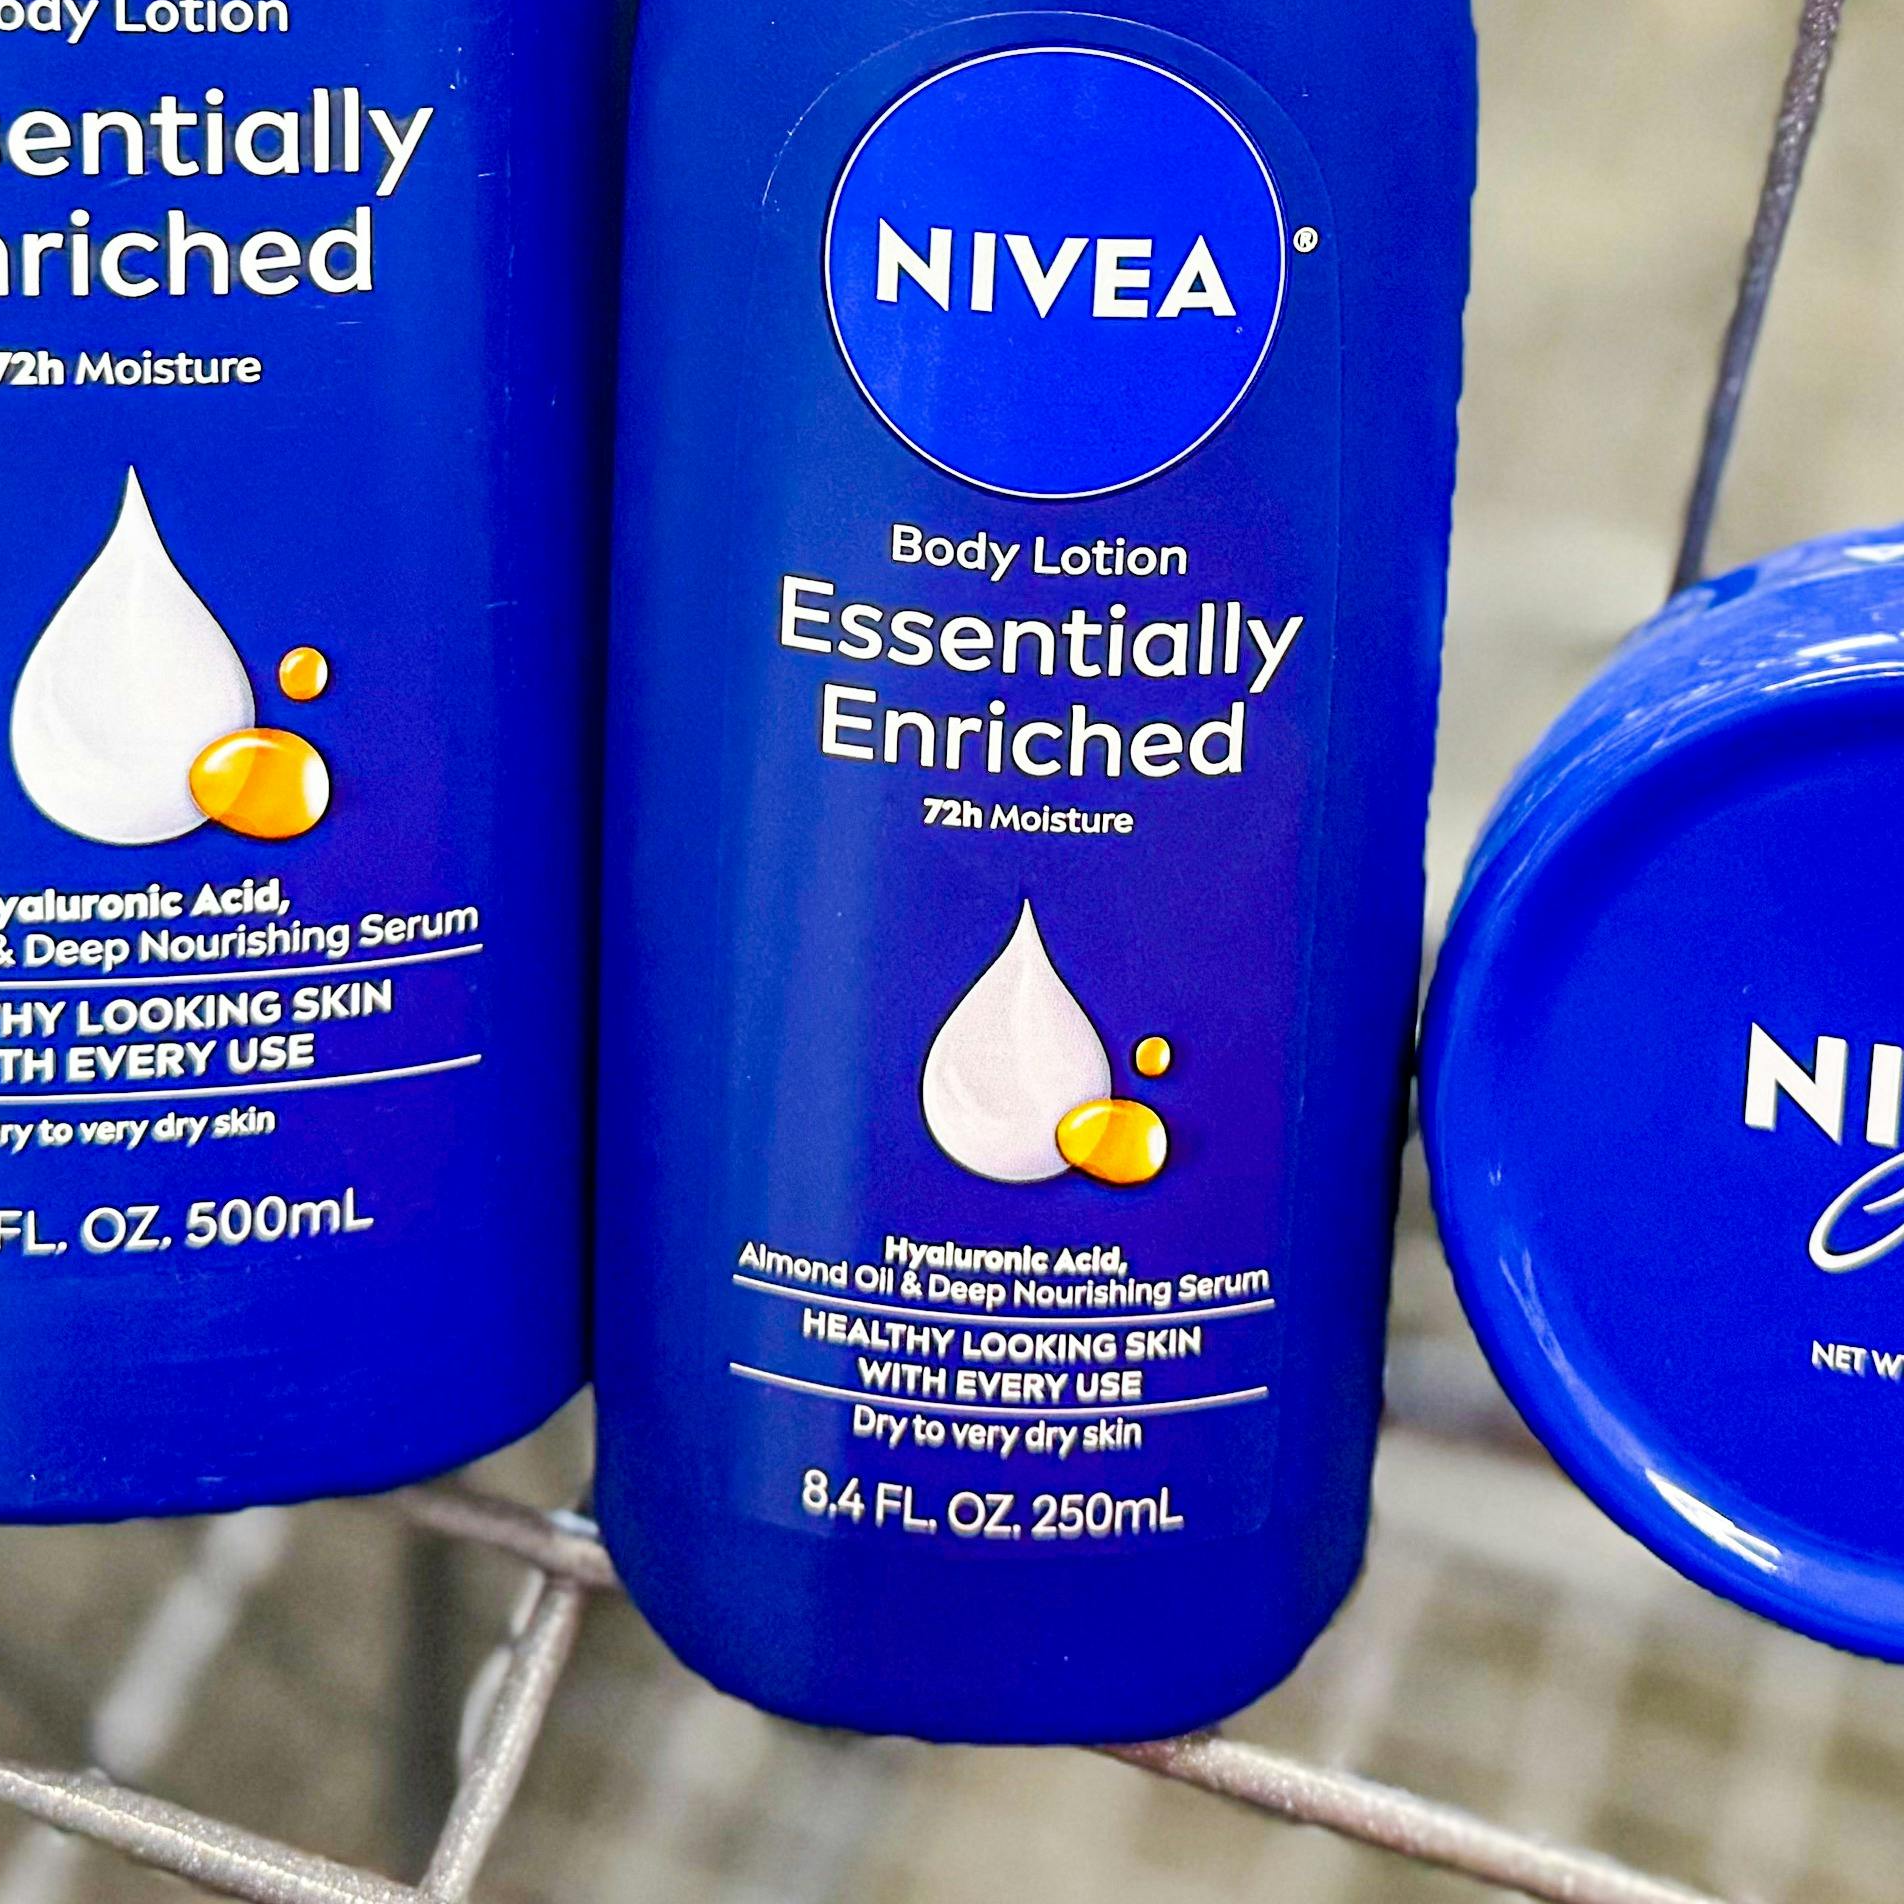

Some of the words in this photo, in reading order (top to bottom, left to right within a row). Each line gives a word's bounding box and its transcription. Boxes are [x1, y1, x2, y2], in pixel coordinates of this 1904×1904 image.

[75, 350, 261, 385] Moisture
[893, 524, 1020, 581] Body
[1034, 537, 1186, 575] Lotion
[782, 575, 1303, 693] Essentially
[823, 684, 1244, 777] Enriched
[924, 798, 982, 828] 72h
[991, 804, 1133, 833] Moisture
[190, 878, 290, 916] Acid,
[25, 934, 129, 971] Deep
[139, 919, 350, 962] Nourishing
[360, 907, 479, 947] Serum
[78, 991, 283, 1036] LOOKING
[293, 979, 391, 1021] SKIN
[68, 1041, 216, 1081] EVERY
[229, 1033, 314, 1073] USE
[38, 1119, 73, 1144] to
[80, 1120, 149, 1149] very
[153, 1112, 208, 1145] dry
[214, 1106, 275, 1137] skin
[82, 1206, 171, 1252] OZ.
[187, 1188, 373, 1246] 500mL
[739, 1242, 848, 1287] Almond
[855, 1265, 894, 1294] Oil
[901, 1270, 923, 1299] &
[927, 1273, 1006, 1312] Deep
[1014, 1279, 1172, 1310] Nourishing
[1179, 1269, 1270, 1301] Serum
[884, 1236, 1048, 1270] Hyaluronic
[1054, 1246, 1128, 1274] Acid,
[804, 1307, 955, 1355] HEALTHY
[963, 1331, 1116, 1362] LOOKING
[1125, 1326, 1201, 1360] SKIN
[1812, 1341, 1867, 1372] NET
[857, 1357, 947, 1397] WITH
[955, 1371, 1069, 1404] EVERY
[1077, 1371, 1142, 1401] USE
[854, 1404, 909, 1450] Dry
[913, 1415, 945, 1444] to
[952, 1423, 1020, 1459] very
[1025, 1420, 1078, 1460] dry
[1083, 1417, 1143, 1449] skin
[803, 1470, 864, 1519] 8.4
[877, 1483, 936, 1530] FL.
[949, 1492, 1020, 1536] OZ.
[1032, 1487, 1183, 1536] 250mL
